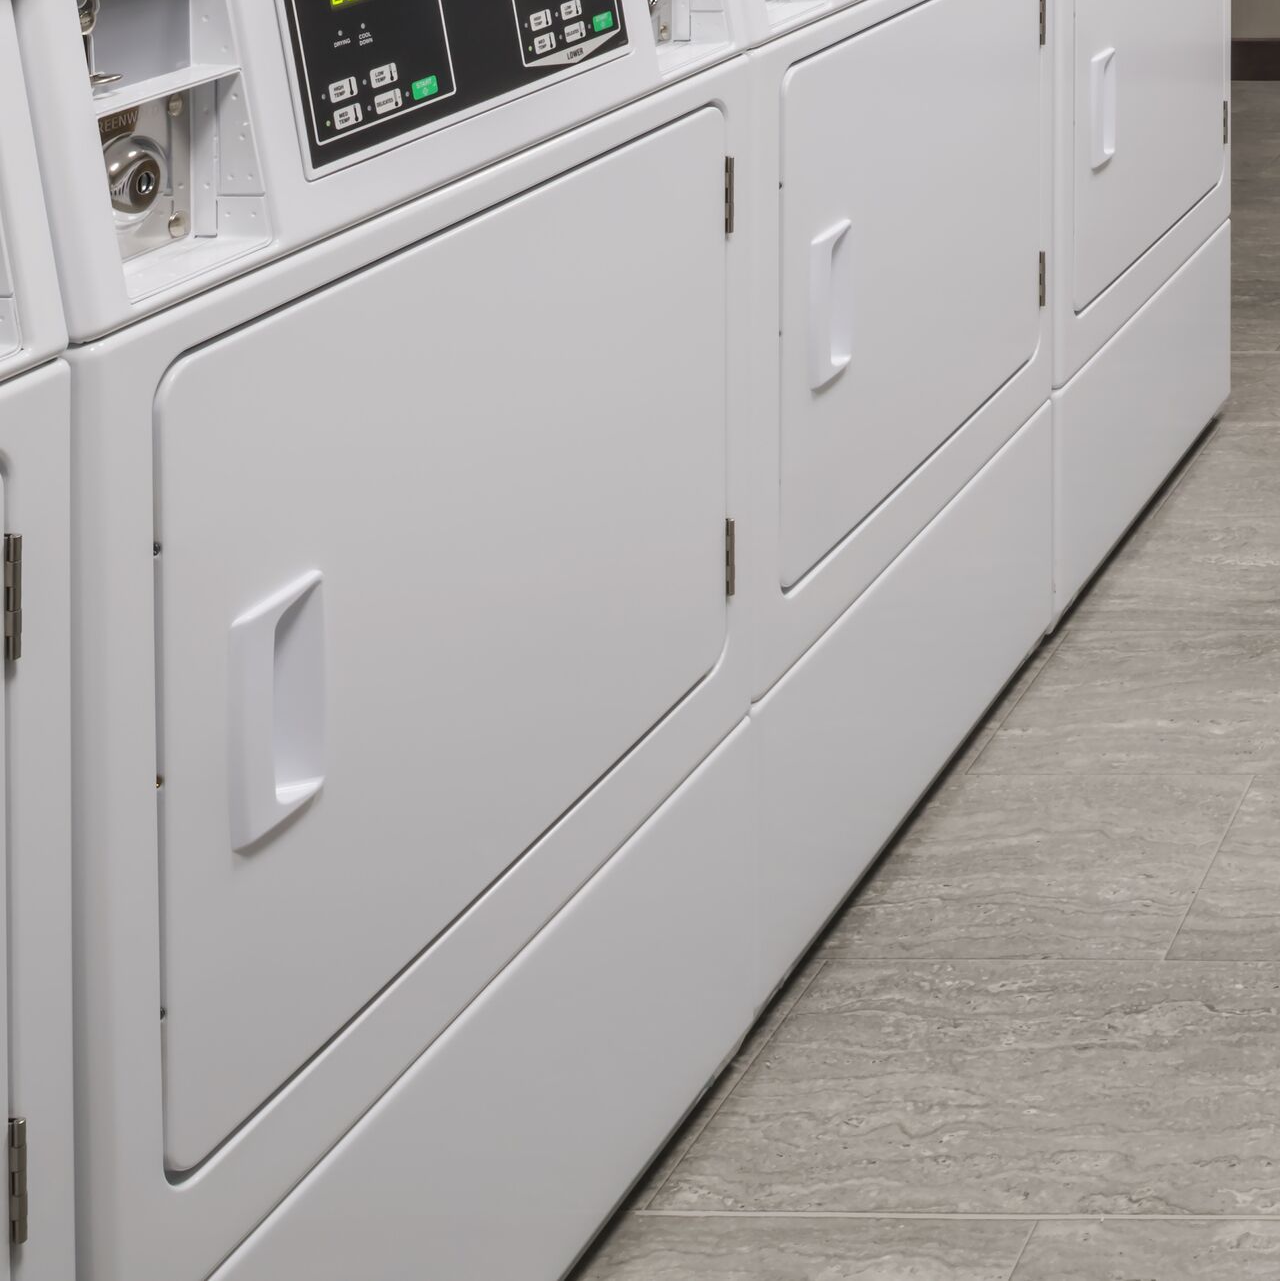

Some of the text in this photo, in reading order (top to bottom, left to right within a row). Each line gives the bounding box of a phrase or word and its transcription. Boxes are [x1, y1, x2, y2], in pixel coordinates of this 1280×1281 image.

[358, 32, 371, 40] COOL
[334, 38, 351, 48] DRYING
[359, 38, 373, 47] DOWN
[567, 47, 583, 60] LOWER
[375, 70, 384, 78] LOW
[375, 75, 386, 83] TEMP
[334, 84, 344, 92] HIGH
[334, 90, 346, 98] TEMP
[339, 117, 350, 125] TEMP
